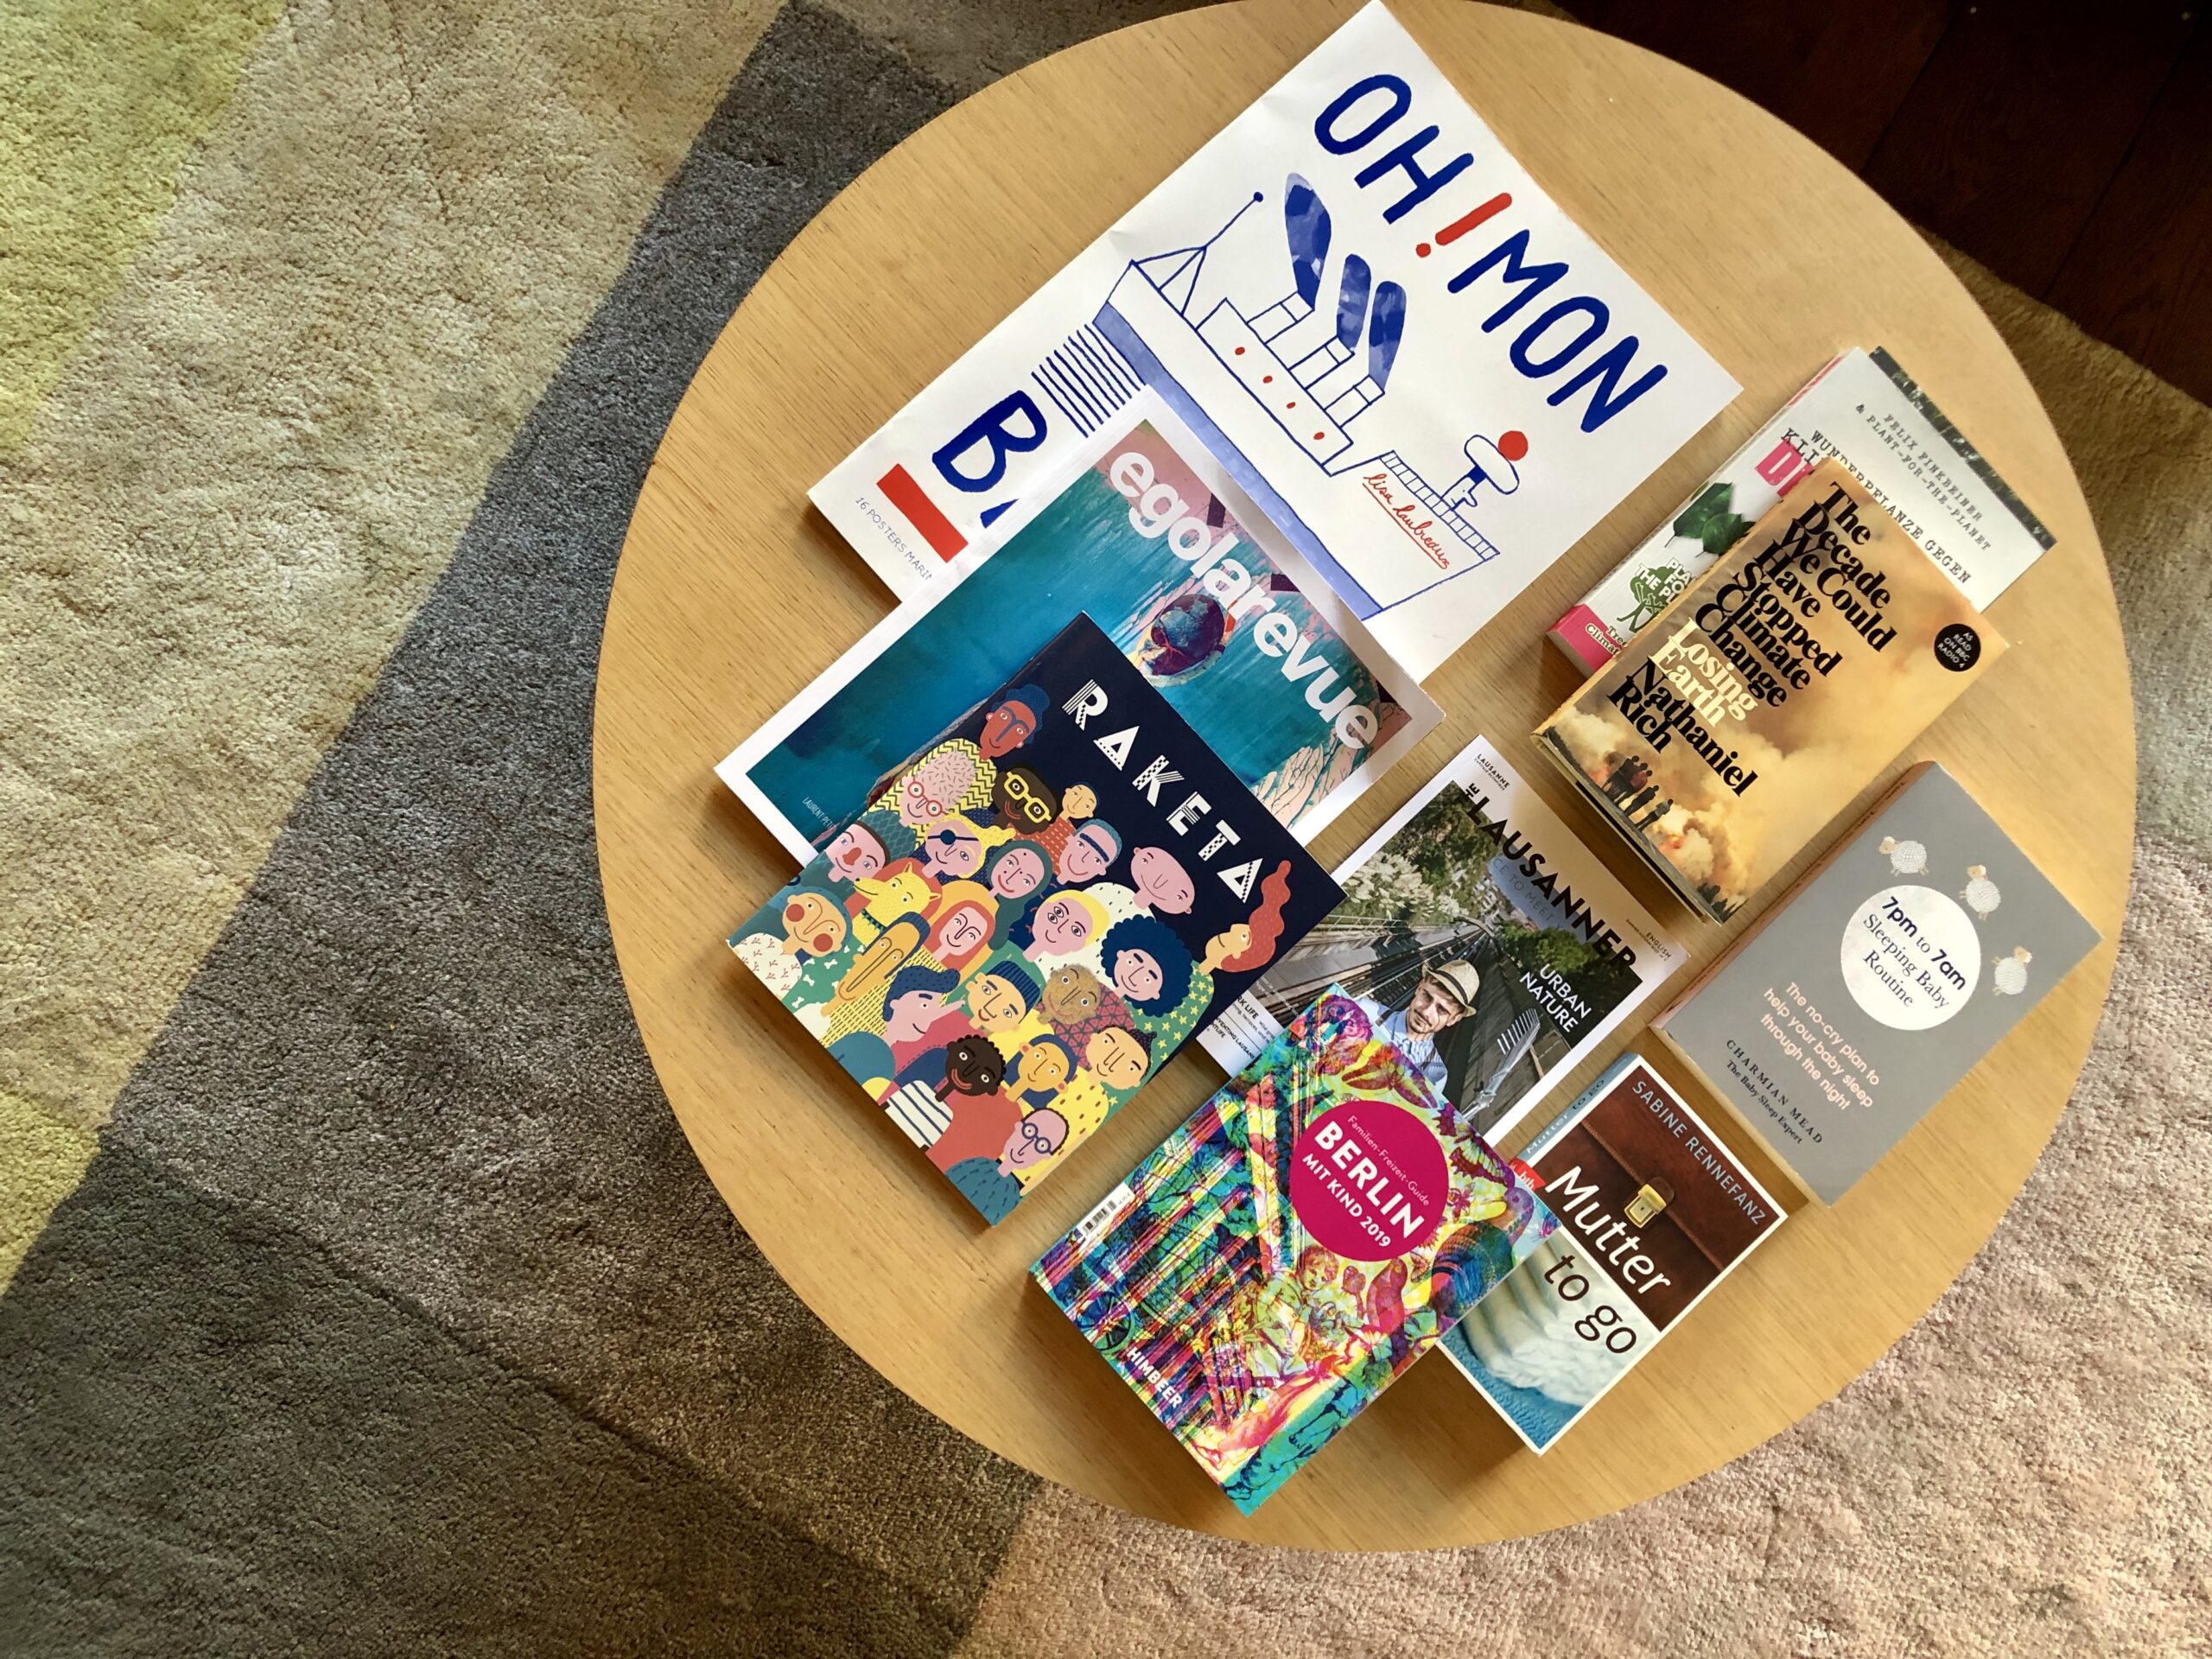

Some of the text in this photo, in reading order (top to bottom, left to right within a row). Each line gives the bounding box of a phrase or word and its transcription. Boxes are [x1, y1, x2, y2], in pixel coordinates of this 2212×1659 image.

[1781, 428, 1823, 463] KLI
[1855, 404, 1866, 414] &
[932, 390, 1048, 529] B
[1884, 413, 1984, 522] FELIX FINKBEINER
[855, 497, 870, 510] 16
[867, 508, 907, 553] POSTERS
[1792, 499, 1891, 609] Decade
[1821, 481, 1872, 545] The
[1110, 452, 1378, 748] egolarevue
[1635, 563, 1675, 603] THE PL
[1664, 573, 1686, 592] FO
[1752, 539, 1821, 618] Have
[1771, 518, 1898, 652] We Could
[1924, 539, 1972, 584] GEGEN
[1585, 623, 1622, 656] Climat
[1695, 603, 1788, 708] Change
[1716, 583, 1811, 690] Climate
[1732, 562, 1844, 677] Stopped
[1937, 643, 1960, 664] RADIO
[1944, 637, 1970, 662] ON BBC
[1953, 633, 1972, 652] READ
[1962, 632, 1974, 641] AS
[1648, 634, 1726, 728] Earth
[1669, 616, 1758, 721] Losing
[1606, 676, 1673, 753] Rich
[1626, 657, 1759, 798] Nathaniel
[802, 796, 824, 819] LAURENT
[1062, 679, 1263, 904] RAKETA
[1477, 753, 1510, 788] LAUSANNE
[1646, 931, 1672, 958] ENGLISH
[1863, 913, 1949, 1009] Sleeping Baby
[1863, 949, 1914, 1007] Routine
[1882, 895, 1967, 991] 7pm to 7am
[1244, 1003, 1260, 1020] LIFE
[1519, 972, 1579, 1033] NATURE
[1539, 963, 1592, 1020] URBAN
[1786, 982, 1879, 1085] The no-cry plan to
[1726, 1039, 1822, 1144] CHARMIAN MEAD
[1760, 1013, 1851, 1110] through the night
[1764, 988, 1873, 1107] help your baby sleep
[1526, 1114, 1568, 1154] Mutter
[1572, 1097, 1586, 1110] to
[1726, 1059, 1803, 1144] The Baby Sleep Expert
[1314, 1121, 1426, 1239] BERLIN
[1347, 1115, 1430, 1206] Familien-Freizeit-Guide
[1631, 1080, 1767, 1226] SABINE RENNEFANZ
[1302, 1153, 1391, 1248] MIT KIND 2019
[1545, 1166, 1672, 1294] Mutter
[1544, 1254, 1637, 1354] to go
[1126, 1347, 1183, 1408] HIMBEER
